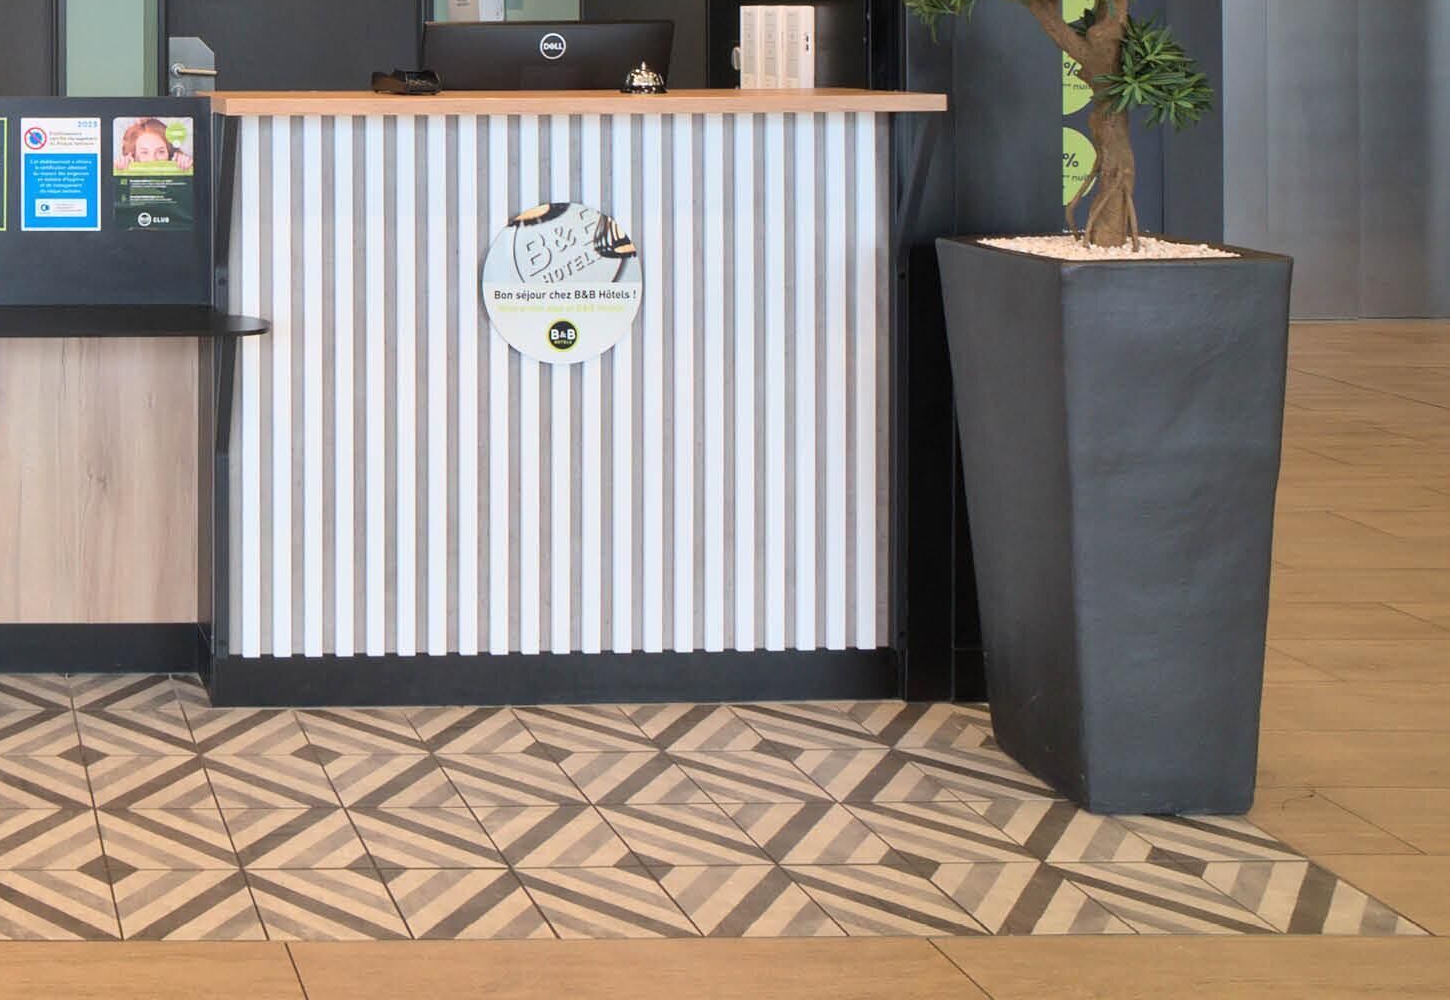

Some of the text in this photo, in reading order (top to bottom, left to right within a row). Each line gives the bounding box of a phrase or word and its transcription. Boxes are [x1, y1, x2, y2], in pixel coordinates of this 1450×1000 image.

[543, 42, 564, 50] DELL
[152, 216, 170, 224] CLUB
[494, 290, 513, 300] Bon
[515, 289, 546, 302] séjour
[549, 290, 571, 300] chez
[574, 290, 596, 300] B&B
[598, 289, 630, 300] Hôtels
[550, 328, 576, 341] B&B
